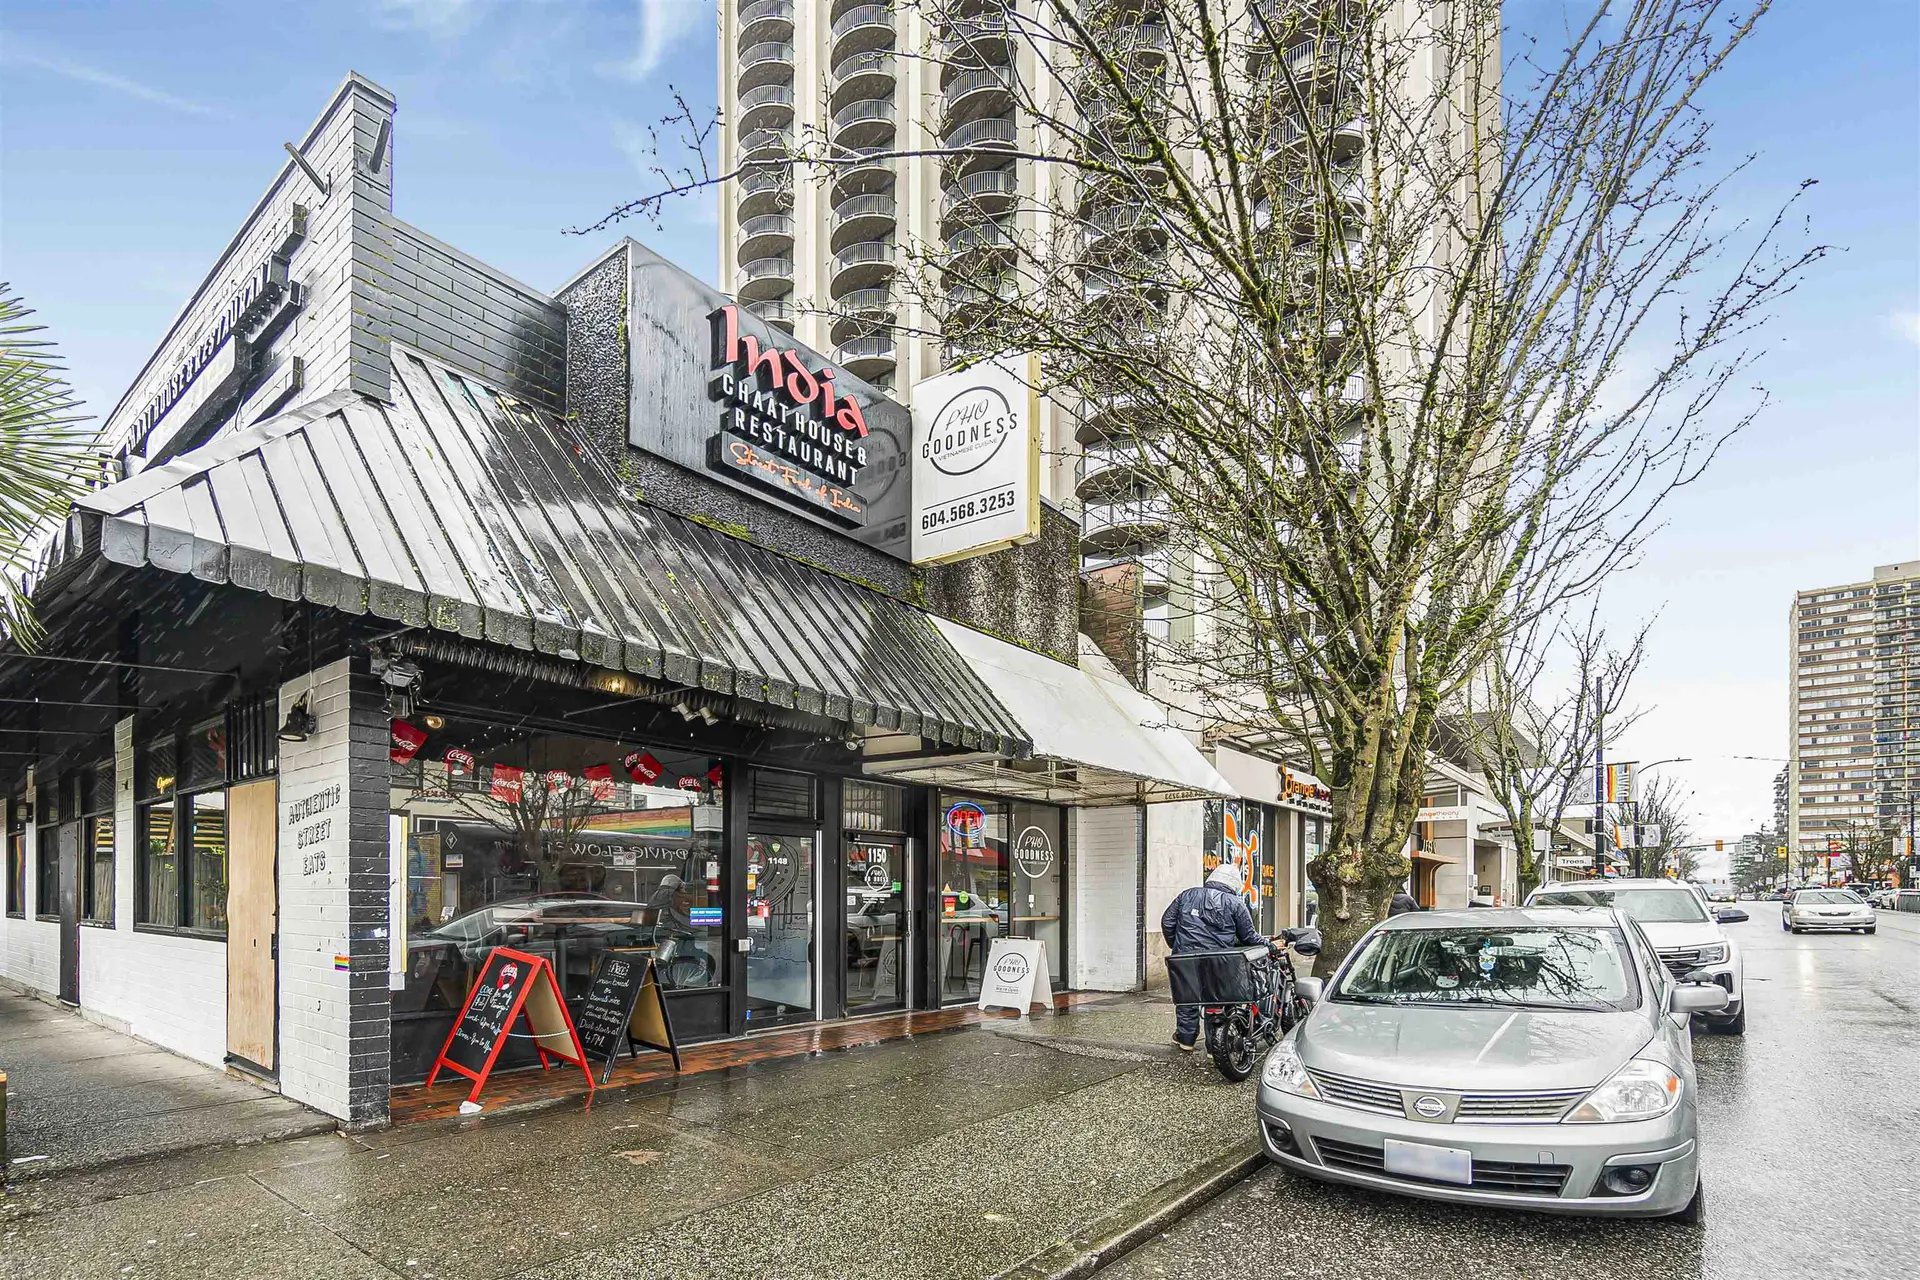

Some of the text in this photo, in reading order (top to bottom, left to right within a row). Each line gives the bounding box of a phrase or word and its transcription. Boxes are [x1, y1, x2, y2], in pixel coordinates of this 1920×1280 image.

[721, 305, 869, 438] India
[723, 373, 789, 423] CHAAT
[795, 411, 854, 460] HOUSE
[857, 446, 868, 467] &
[945, 399, 989, 431] PHO
[735, 407, 858, 486] RESTAURANT
[922, 412, 1018, 459] GOODNESS
[937, 437, 998, 462] VIETNAMESE CUISINE
[729, 442, 779, 474] Street
[777, 465, 812, 490] Food
[829, 488, 861, 513] India
[922, 490, 1015, 530] 604.568.3253
[288, 783, 342, 826] AUTHENTIC
[950, 809, 983, 829] OPEN
[297, 818, 332, 850] STREET
[1024, 835, 1044, 848] PHO
[302, 850, 326, 877] EATS
[767, 857, 788, 865] 1148
[868, 847, 887, 863] 1150
[1014, 848, 1054, 862] GOODNESS
[993, 964, 1030, 974] GOODNESS
